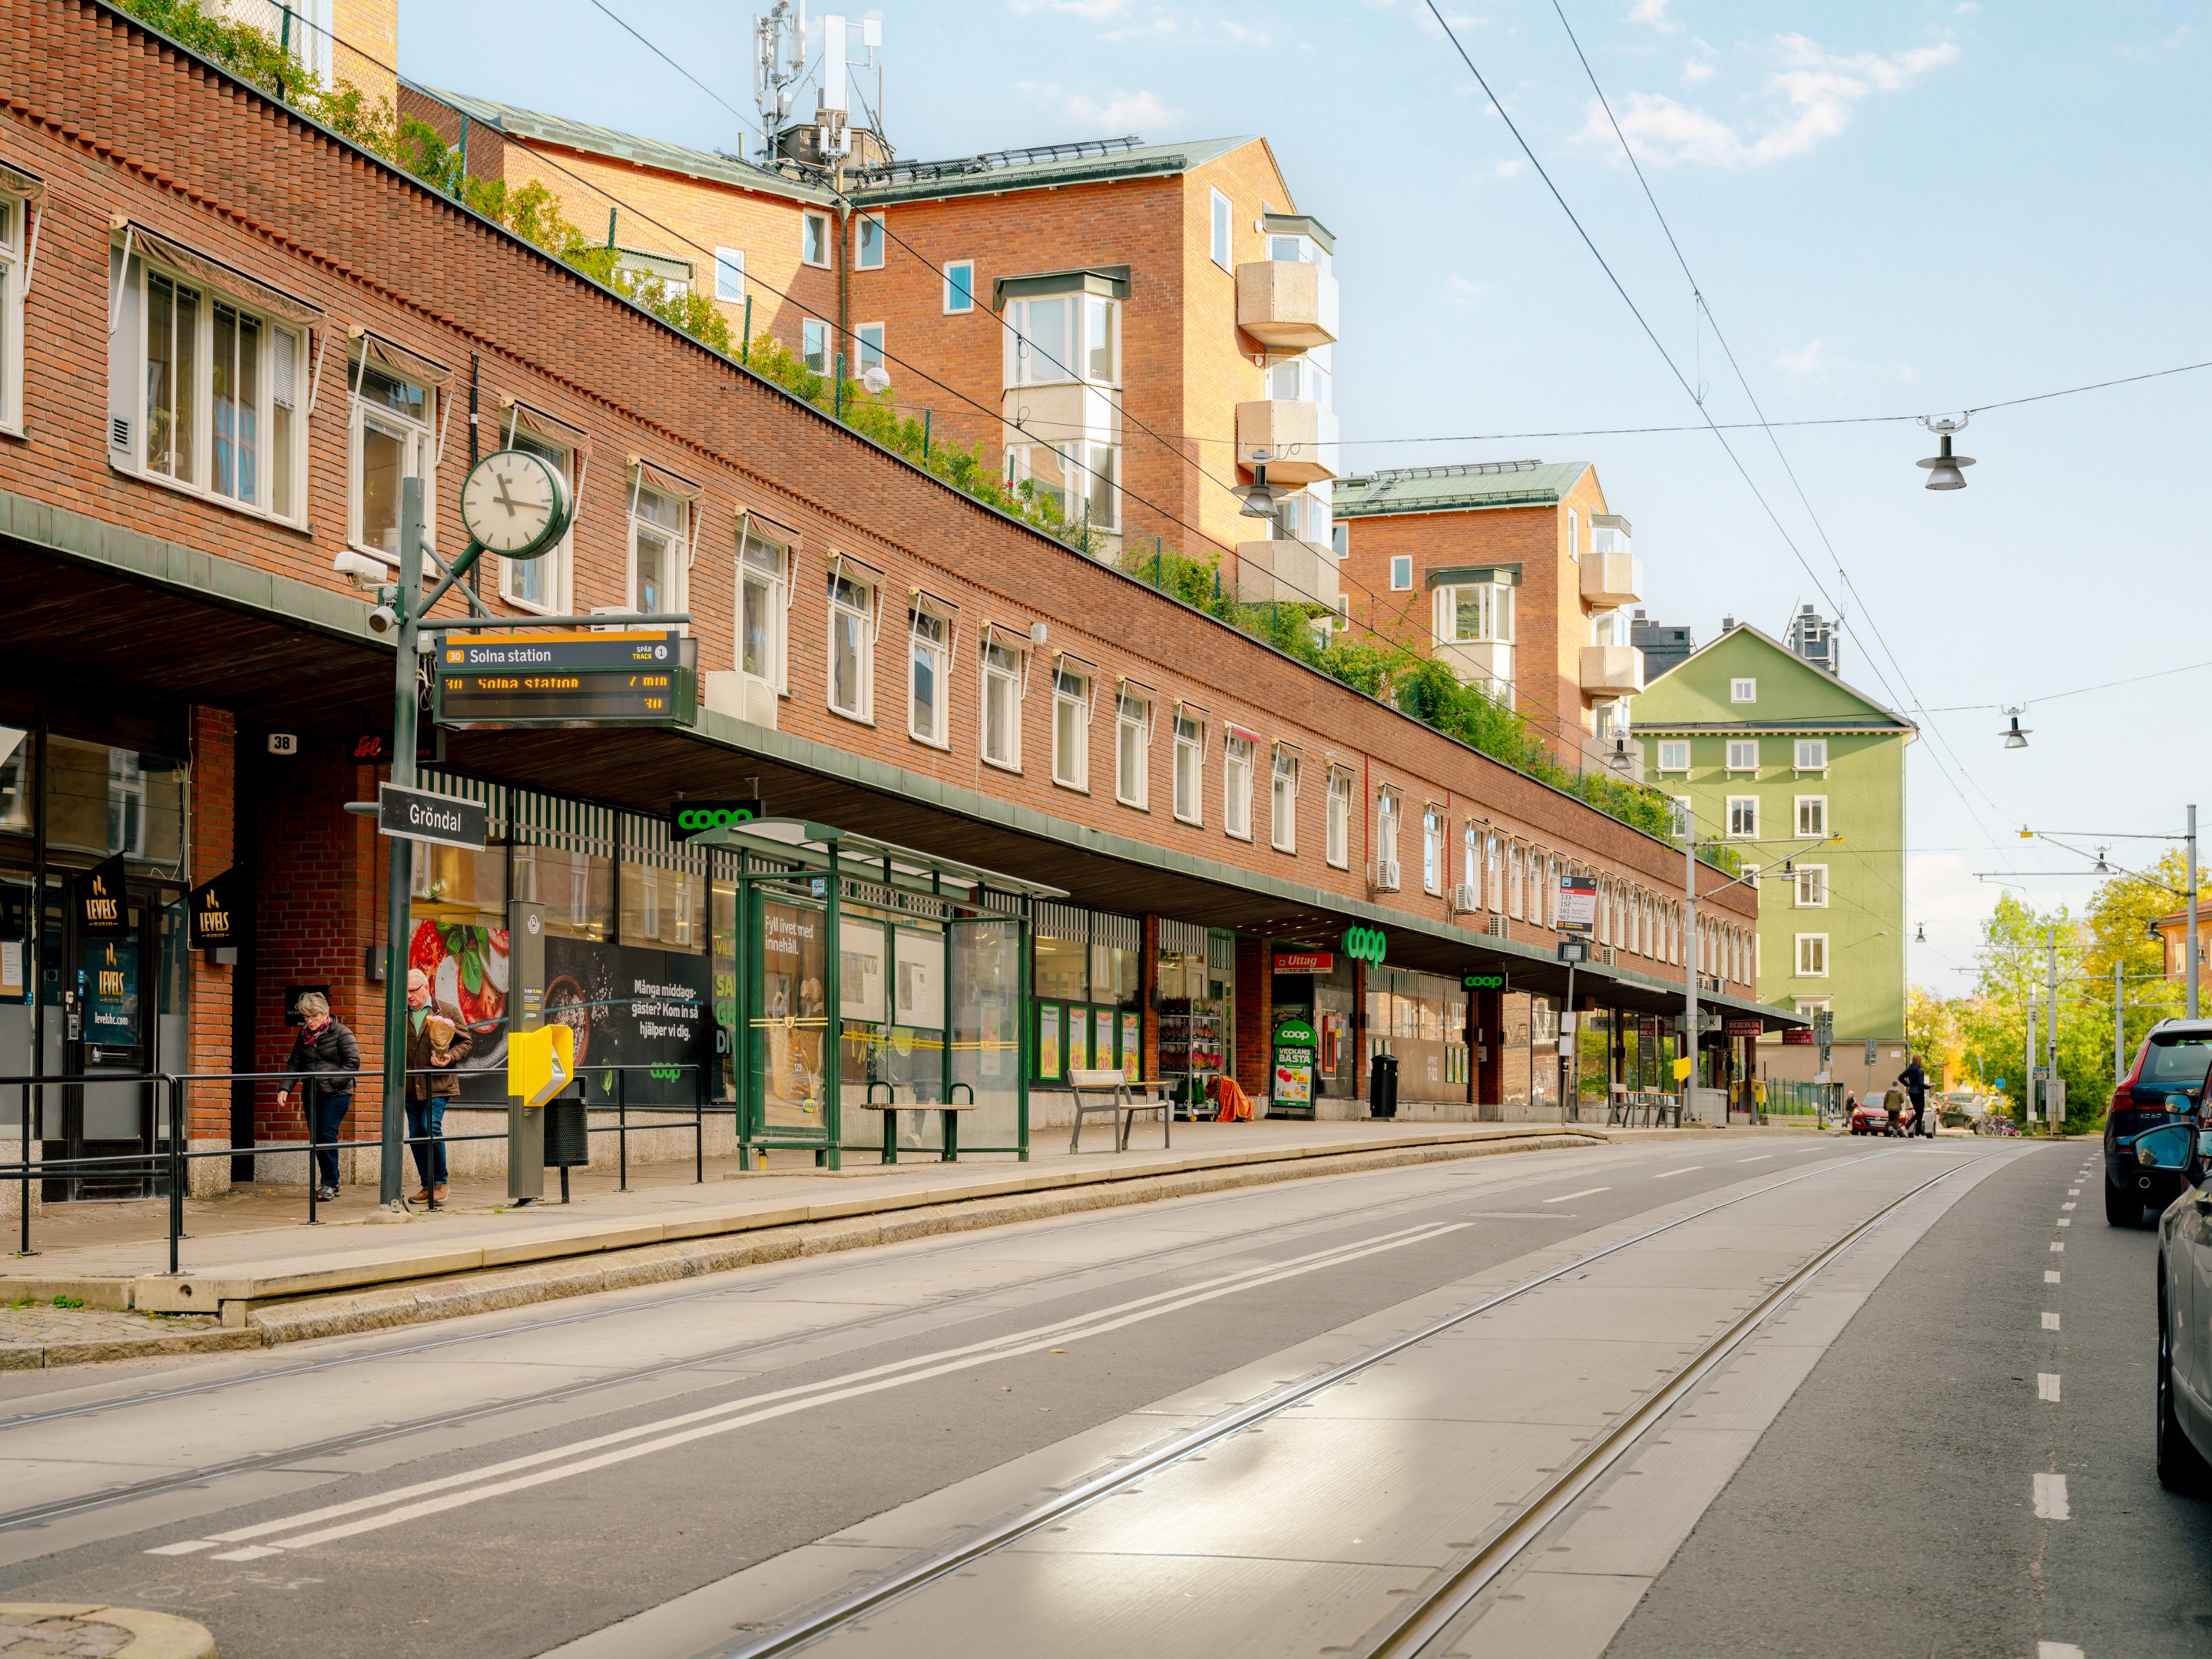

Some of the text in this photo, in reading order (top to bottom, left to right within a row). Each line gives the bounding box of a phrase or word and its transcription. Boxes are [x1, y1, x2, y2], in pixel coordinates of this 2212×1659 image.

[450, 649, 551, 664] 30 Solna station
[636, 645, 653, 653] SPÅR
[478, 678, 518, 689] Solna
[643, 676, 667, 686] min
[273, 736, 290, 750] 38
[409, 803, 461, 832] Gröndal
[86, 899, 118, 920] LEVELS
[199, 911, 229, 932] LEVELS
[765, 915, 813, 939] Fyll livet med
[765, 934, 799, 955] innehåll.
[1343, 925, 1386, 970] coop
[1288, 955, 1318, 968] Uttag
[99, 970, 124, 996] LEVELS
[634, 979, 696, 1002] Många middags-
[716, 975, 736, 997] SA
[1464, 976, 1503, 988] coop
[94, 1012, 128, 1026] levelshc.com
[632, 1001, 699, 1019] gäster? Kom in så
[639, 1021, 691, 1041] hjälper vi dig.
[1282, 1030, 1310, 1040] coop
[1278, 1053, 1310, 1064] BÄSTA
[651, 1061, 681, 1083] coop
